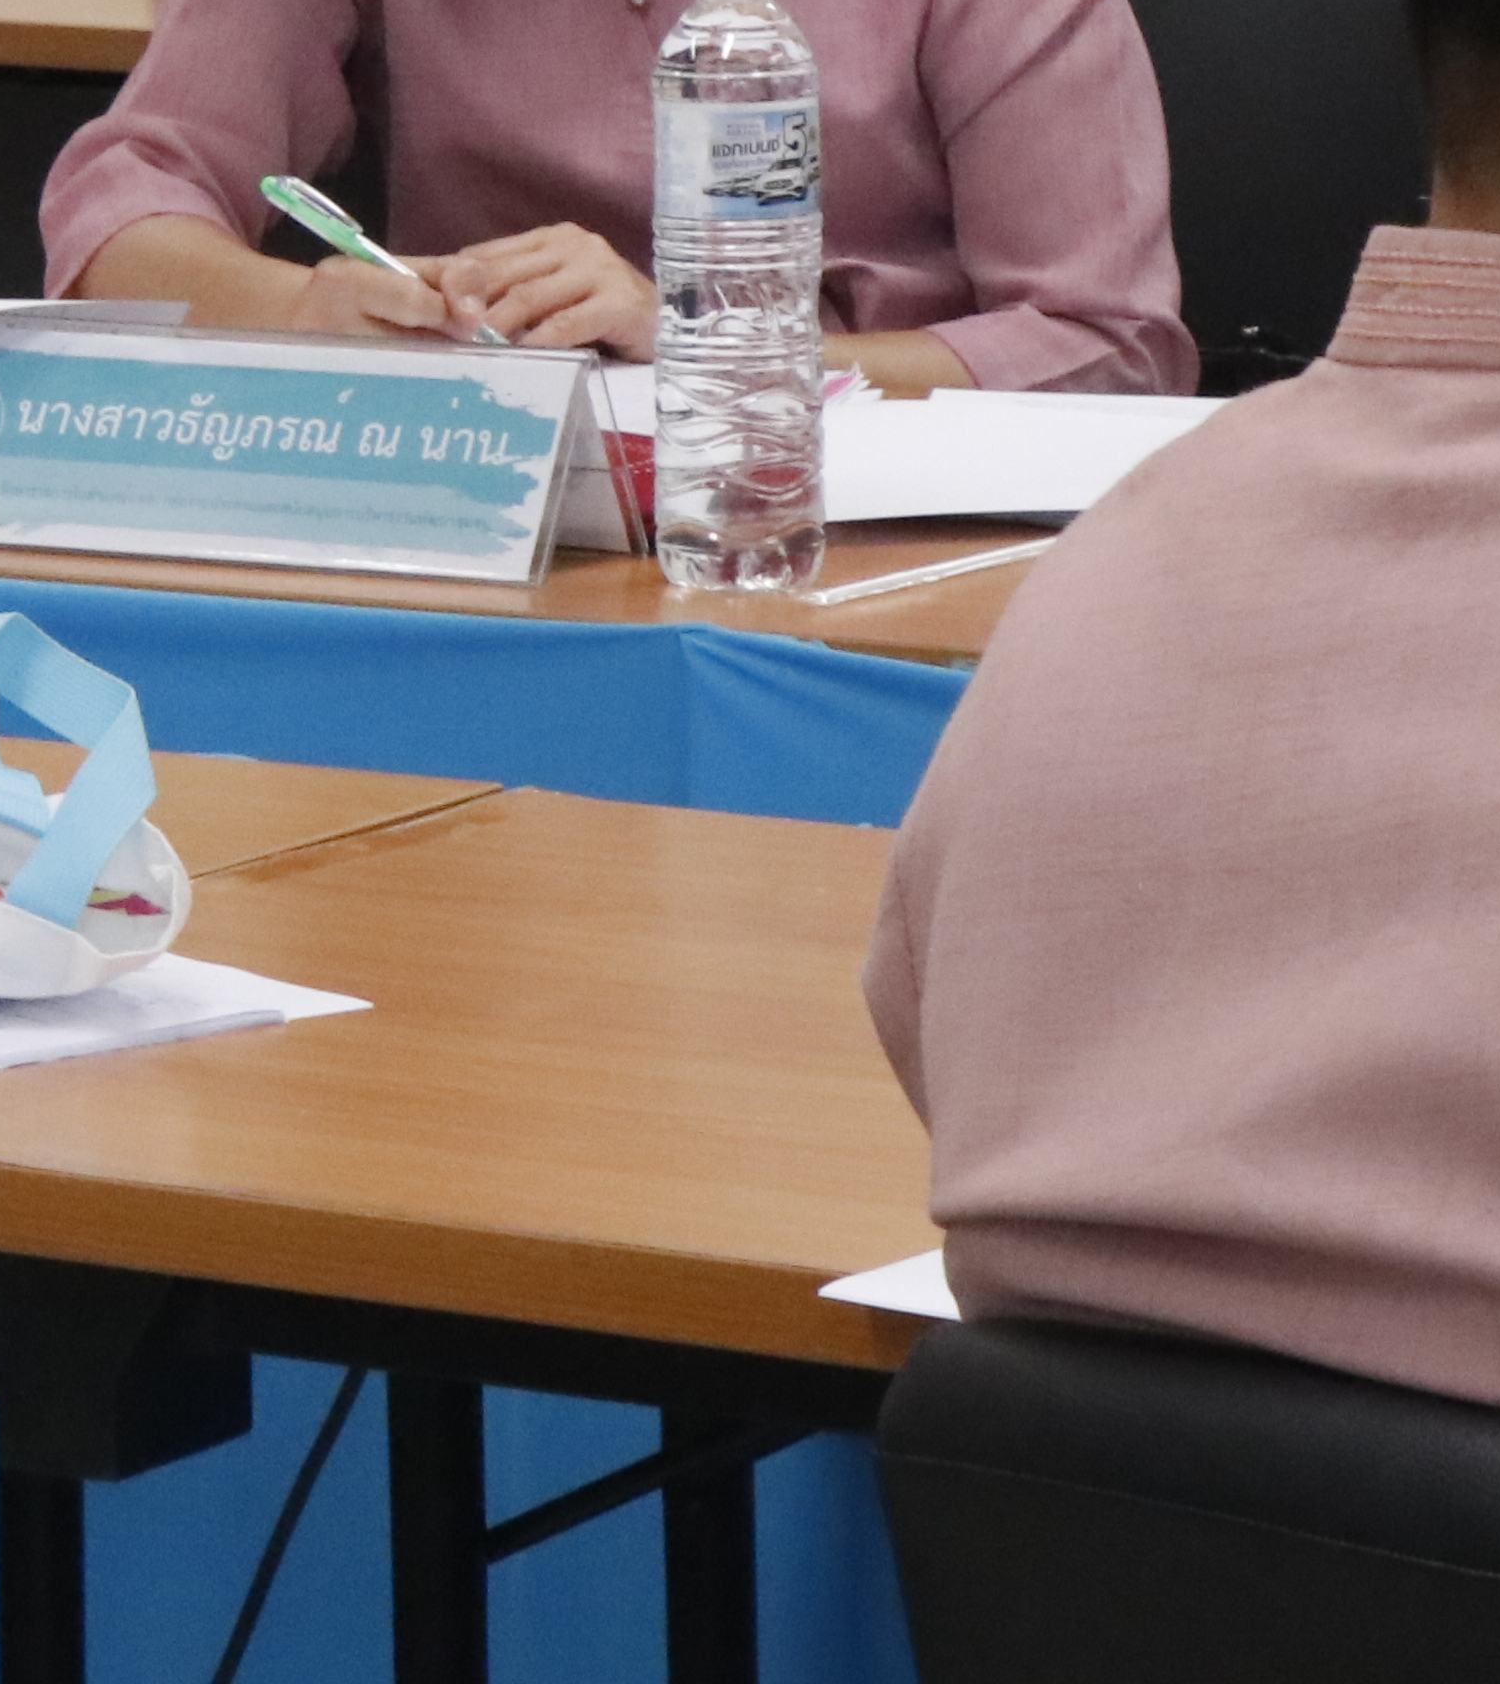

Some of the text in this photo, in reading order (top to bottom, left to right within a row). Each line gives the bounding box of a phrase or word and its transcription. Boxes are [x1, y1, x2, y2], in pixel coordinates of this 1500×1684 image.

[17, 387, 355, 462] นางสาวธัญภรณ์
[357, 419, 401, 459] ณ
